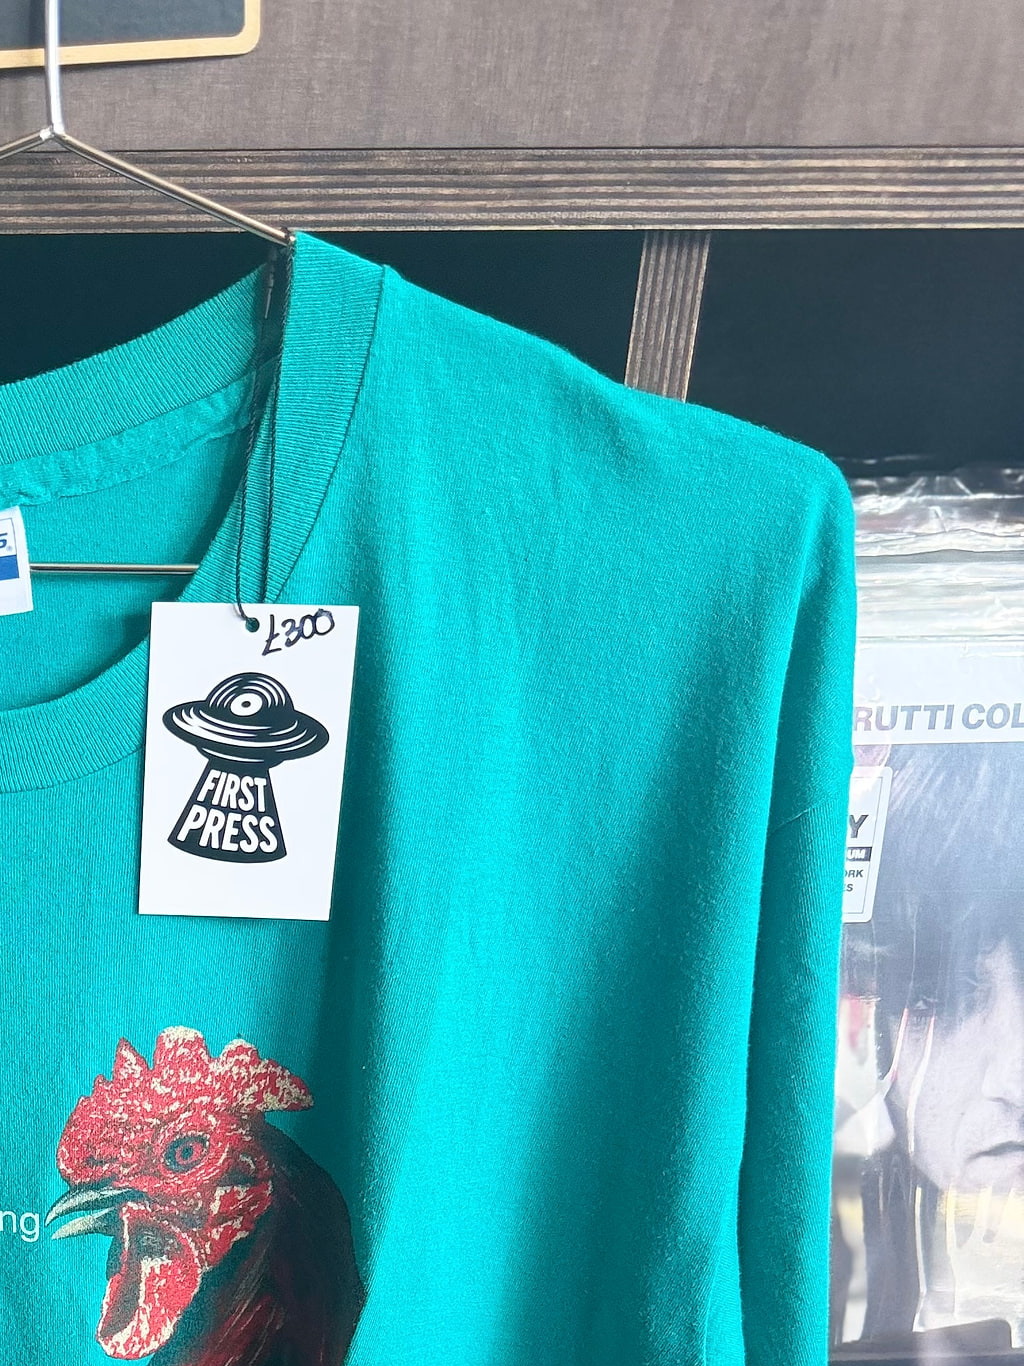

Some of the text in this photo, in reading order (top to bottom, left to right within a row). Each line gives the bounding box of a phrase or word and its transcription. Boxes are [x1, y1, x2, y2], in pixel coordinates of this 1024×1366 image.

[261, 608, 335, 656] £300
[853, 704, 955, 731] RUTTI
[197, 769, 267, 813] FIRST
[177, 804, 278, 854] PRESS
